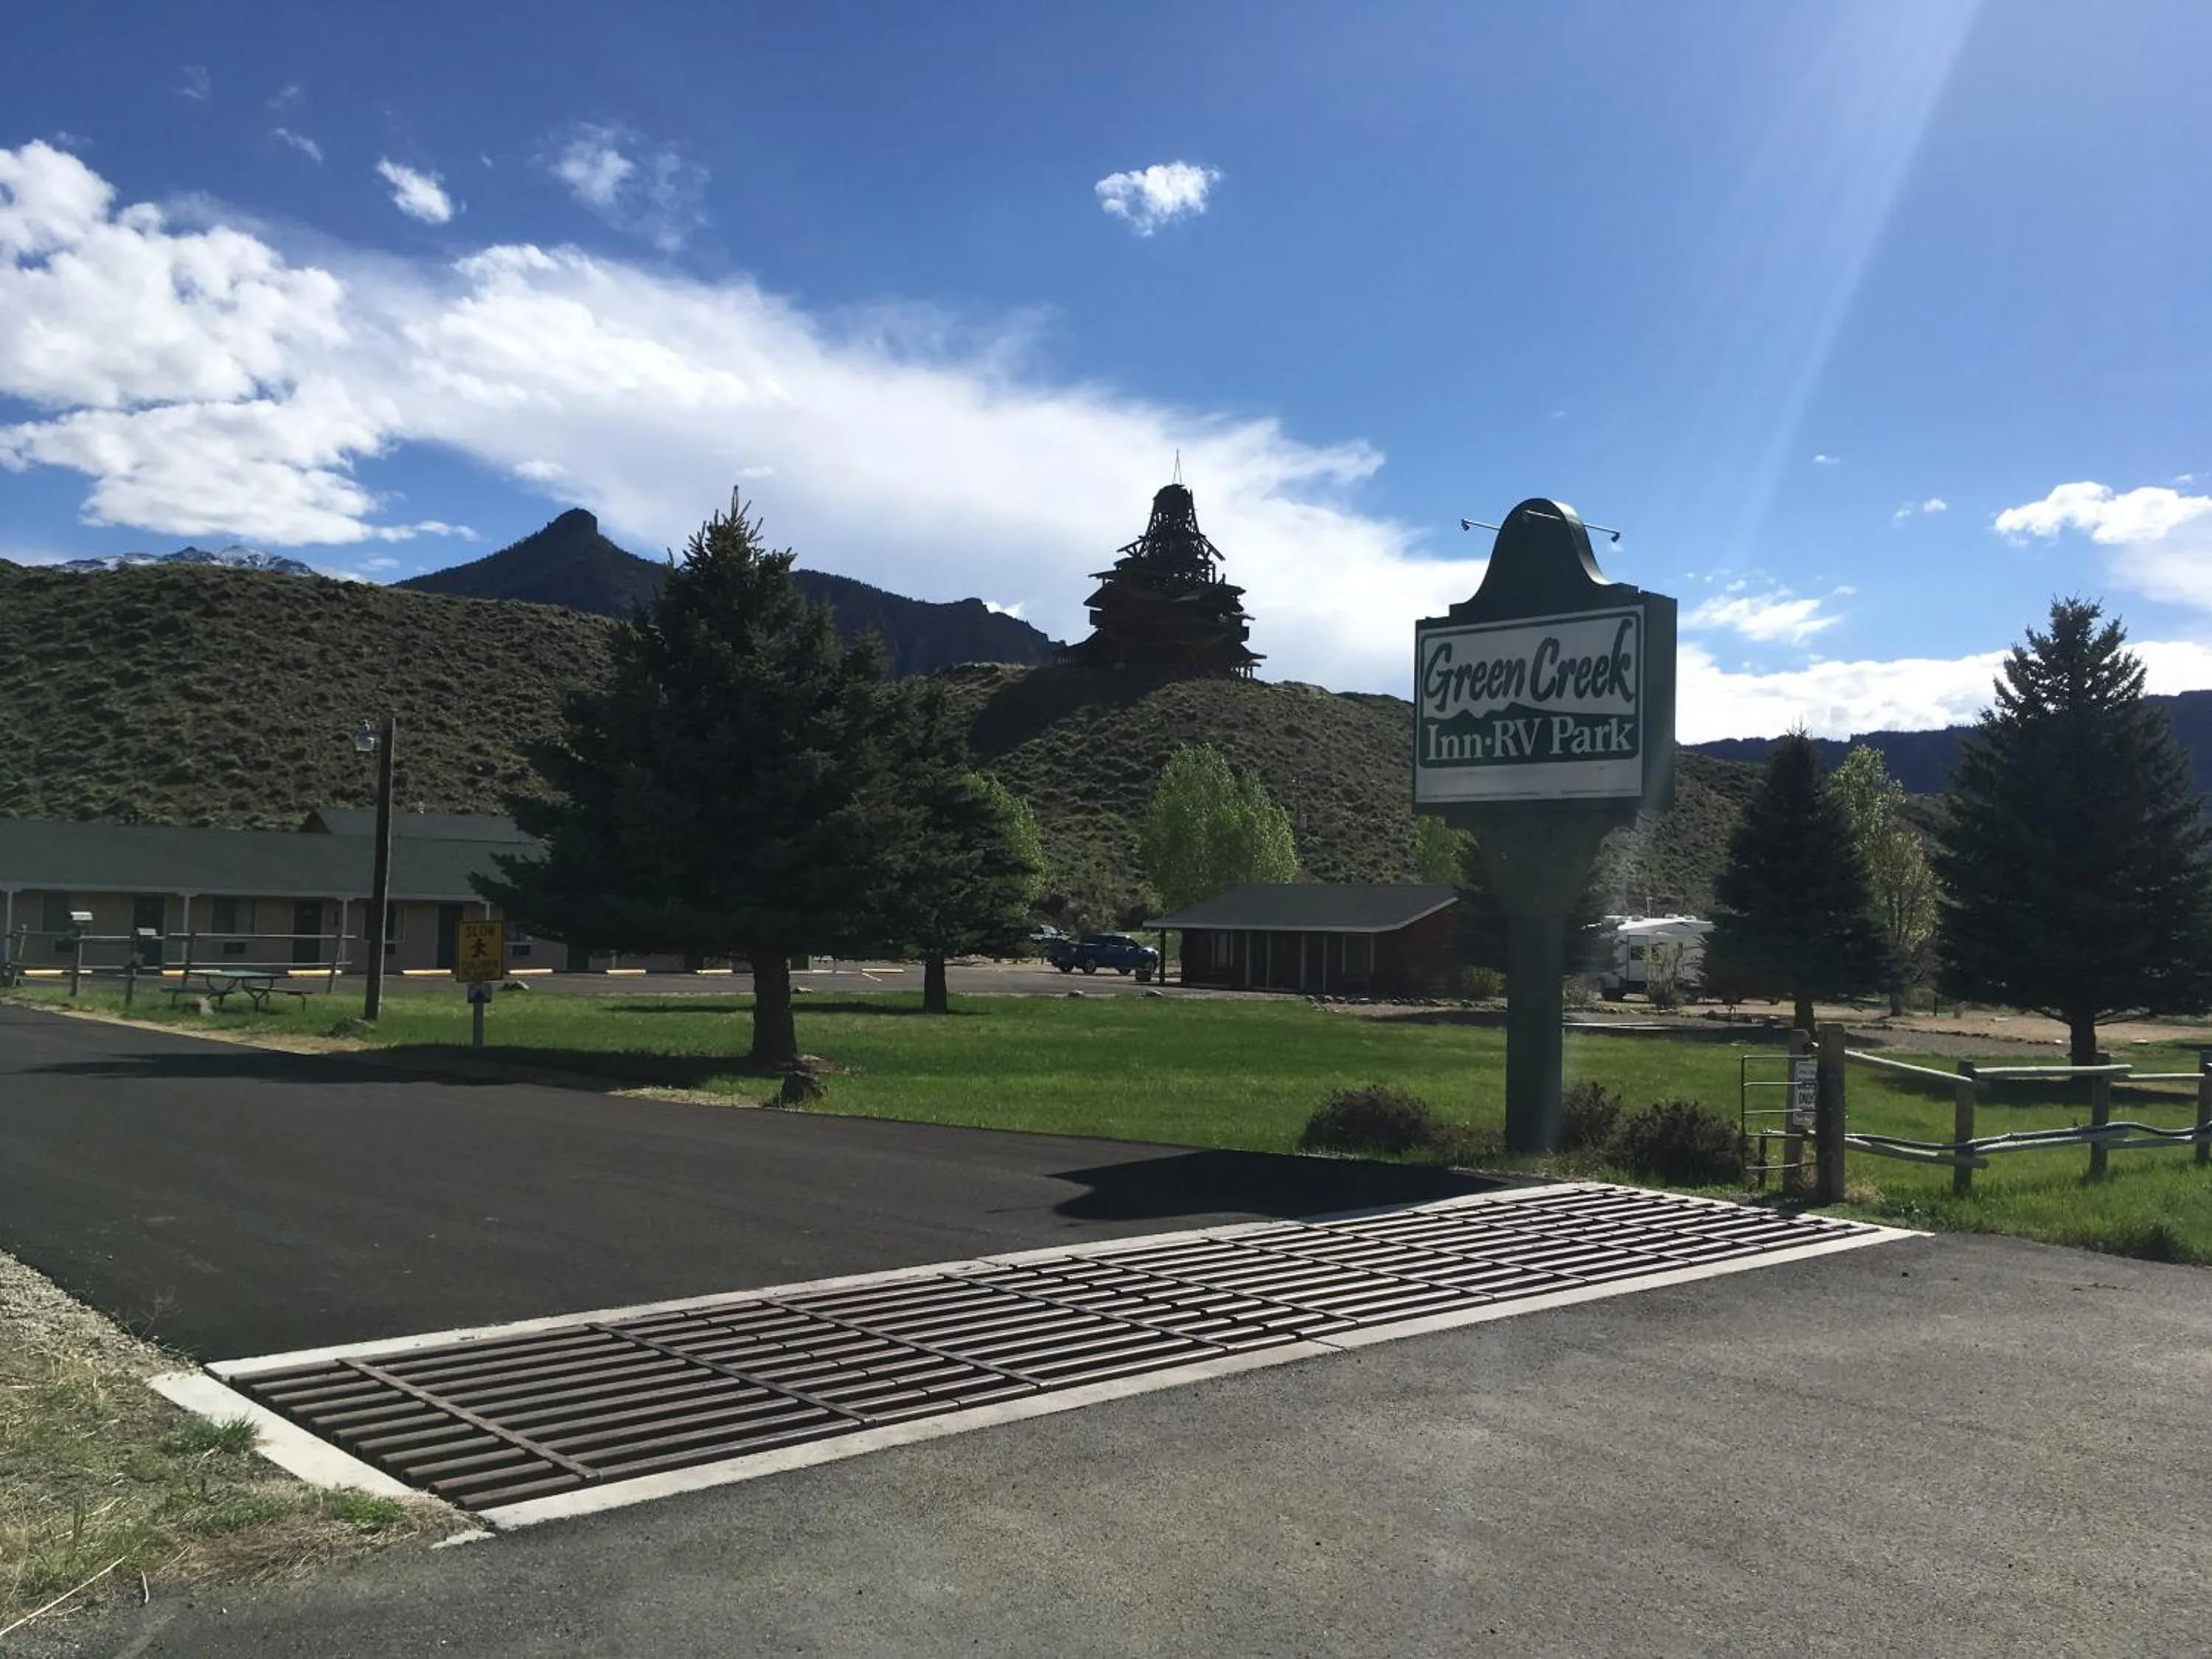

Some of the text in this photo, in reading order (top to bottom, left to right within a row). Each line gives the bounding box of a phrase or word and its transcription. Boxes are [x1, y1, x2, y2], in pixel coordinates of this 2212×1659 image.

[1424, 618, 1635, 712] Green Creek
[1549, 716, 1634, 755] Park
[465, 926, 495, 937] SLOW
